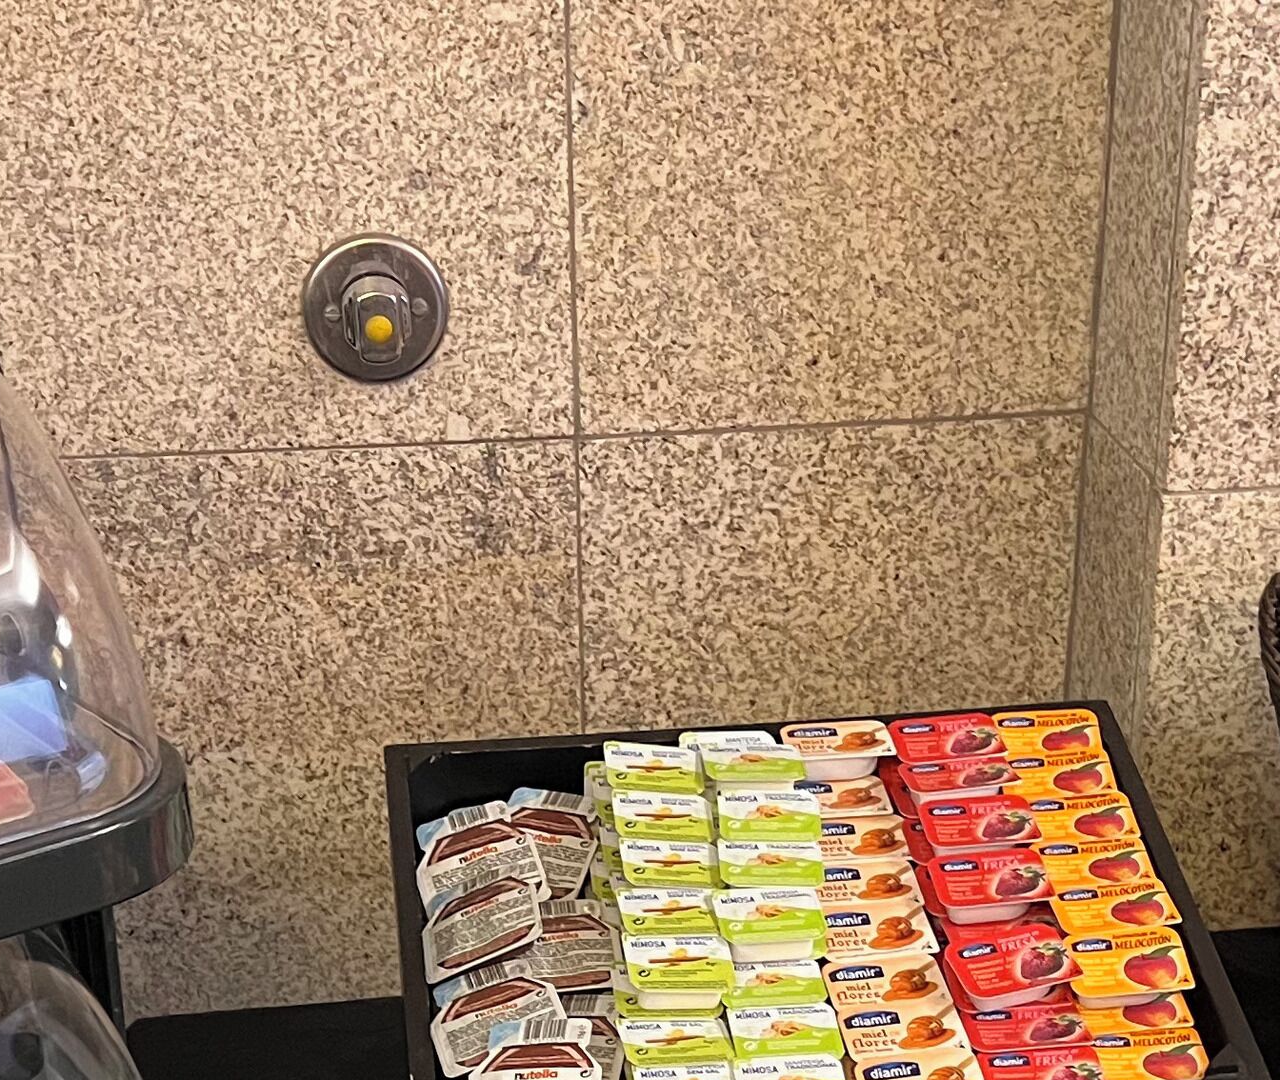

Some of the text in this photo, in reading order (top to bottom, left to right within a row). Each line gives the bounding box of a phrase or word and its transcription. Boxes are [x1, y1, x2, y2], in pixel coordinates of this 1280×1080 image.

[459, 846, 498, 864] nutella
[826, 869, 853, 880] amir
[833, 929, 859, 938] miel
[836, 967, 876, 980] diamir
[846, 982, 871, 992] miel
[851, 1013, 892, 1027] diamir
[861, 1029, 888, 1038] miel
[514, 1069, 558, 1080] nutella
[870, 1065, 912, 1080] diamir
